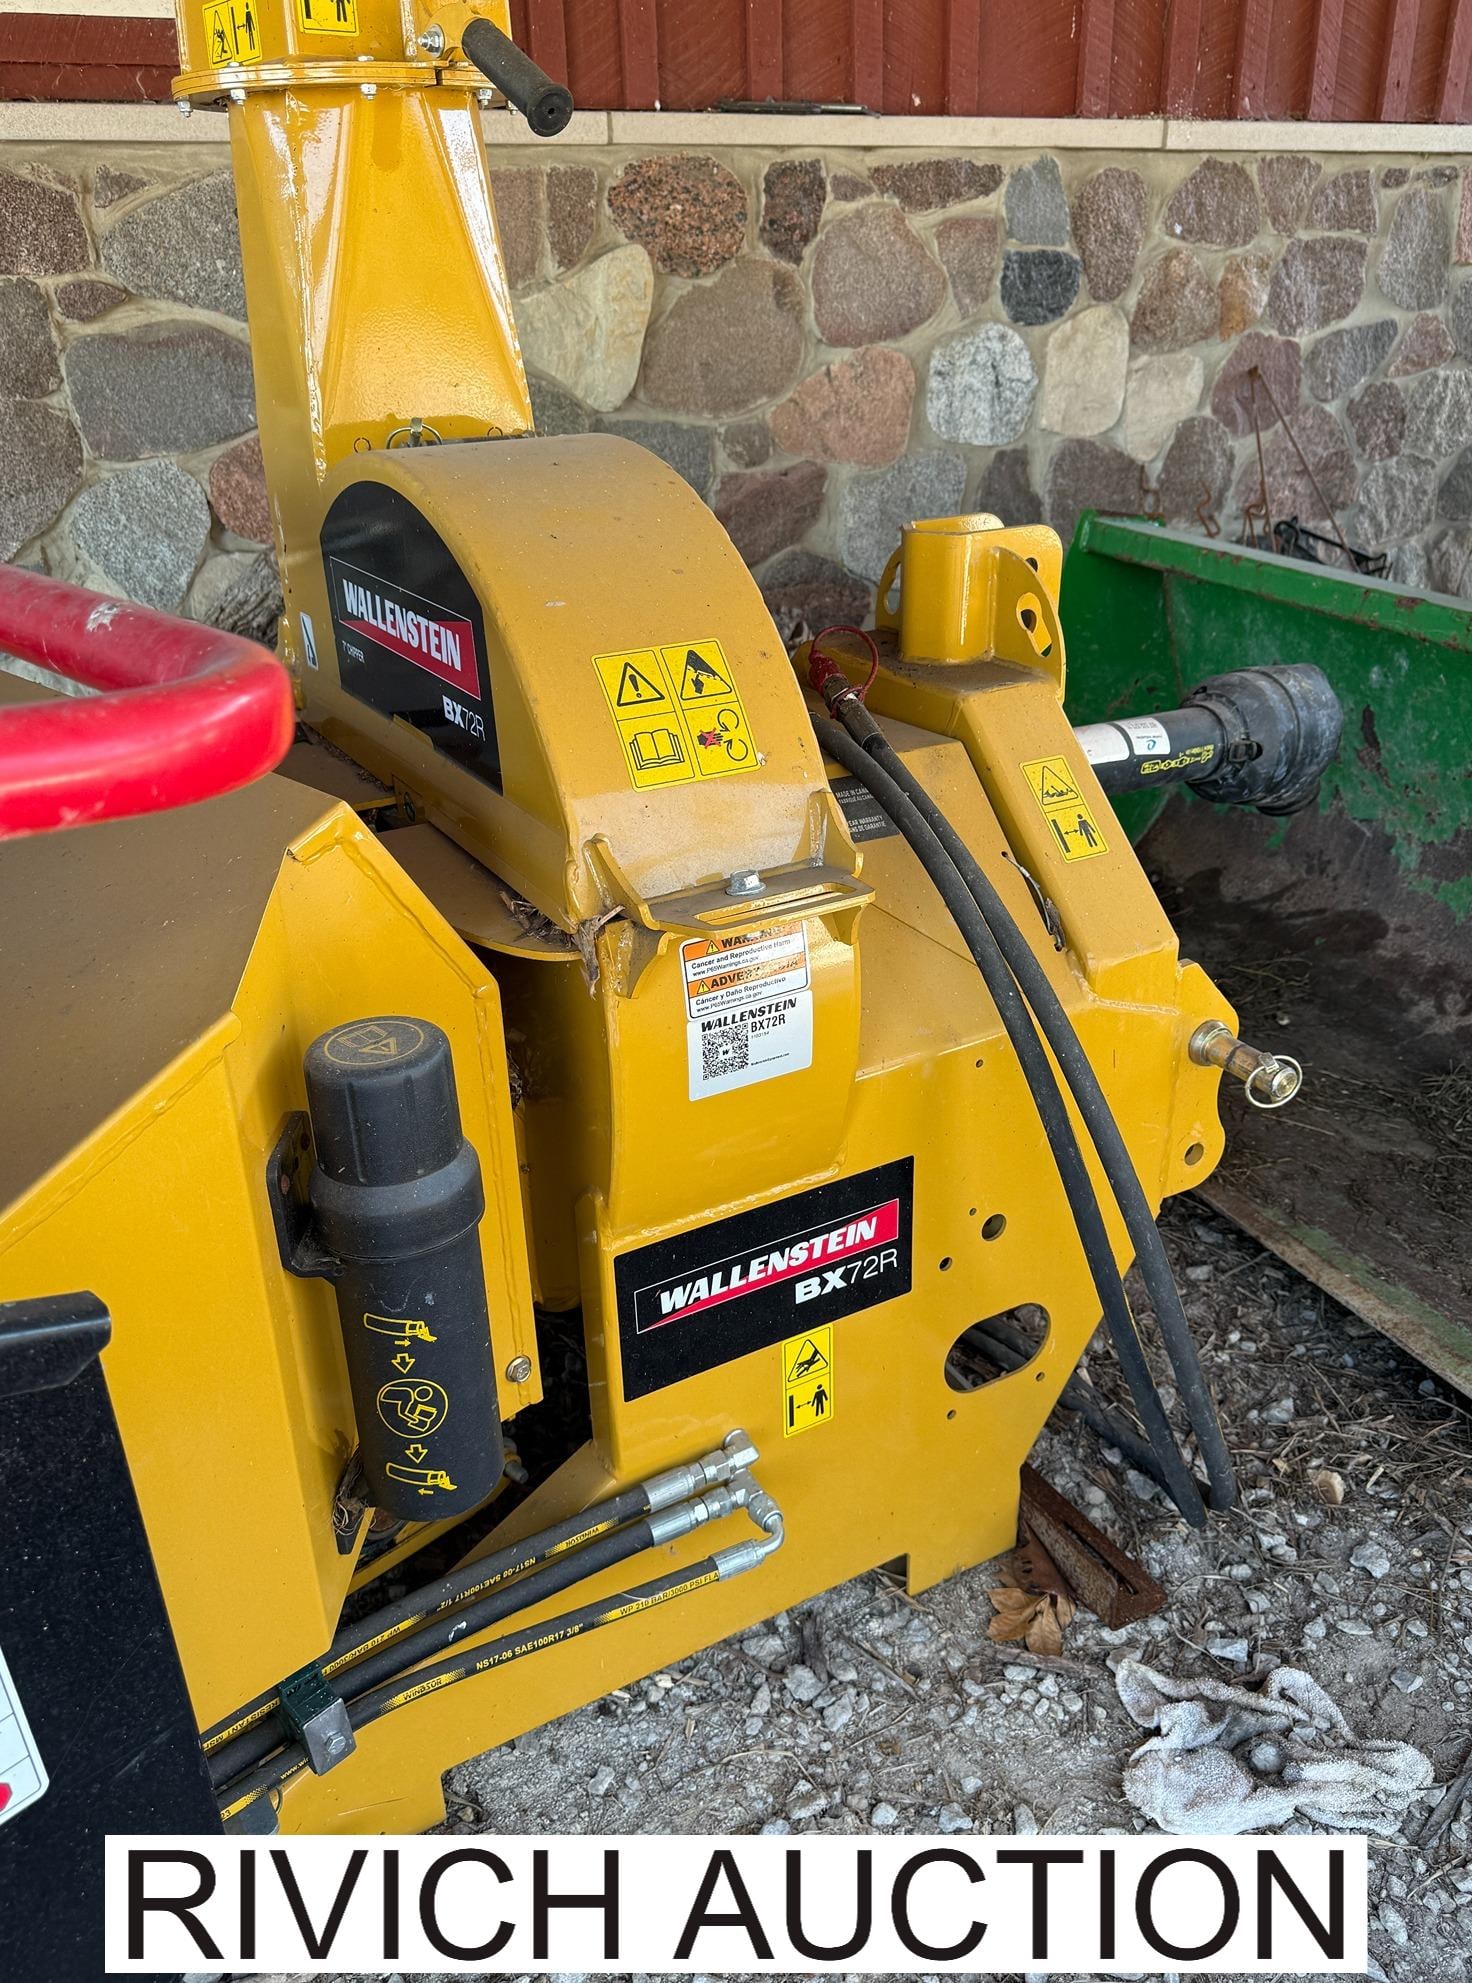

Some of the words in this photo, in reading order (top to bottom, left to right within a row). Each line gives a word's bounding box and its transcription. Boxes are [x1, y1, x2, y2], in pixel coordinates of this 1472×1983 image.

[342, 578, 462, 672] WALLENSTEIN
[442, 695, 486, 742] BX72R
[859, 815, 883, 825] WARRANTY
[691, 960, 716, 970] Cancer
[716, 954, 729, 963] and
[730, 943, 773, 961] Reproductive
[774, 939, 791, 948] Harm
[696, 995, 719, 1006] Cáncer
[726, 988, 743, 998] Daño
[744, 977, 786, 993] Reproductivo
[701, 998, 797, 1033] WALLENSTEIN
[751, 1014, 786, 1032] BX72R
[659, 1217, 877, 1315] WALLENSTEIN
[795, 1248, 898, 1304] BX72R
[565, 1526, 600, 1548] WINDSOR
[455, 1574, 501, 1603] SAE100R17
[476, 1649, 512, 1671] NS17-06
[514, 1630, 564, 1656] SAE100R17
[566, 1622, 584, 1637] 3/8"
[620, 1605, 633, 1616] WP
[635, 1597, 650, 1609] 210
[651, 1584, 688, 1604] BAR/3000
[690, 1578, 703, 1589] PSI
[371, 1635, 385, 1647] 210
[402, 1678, 442, 1702] WINDSOR
[227, 1699, 278, 1736] RESISTANT
